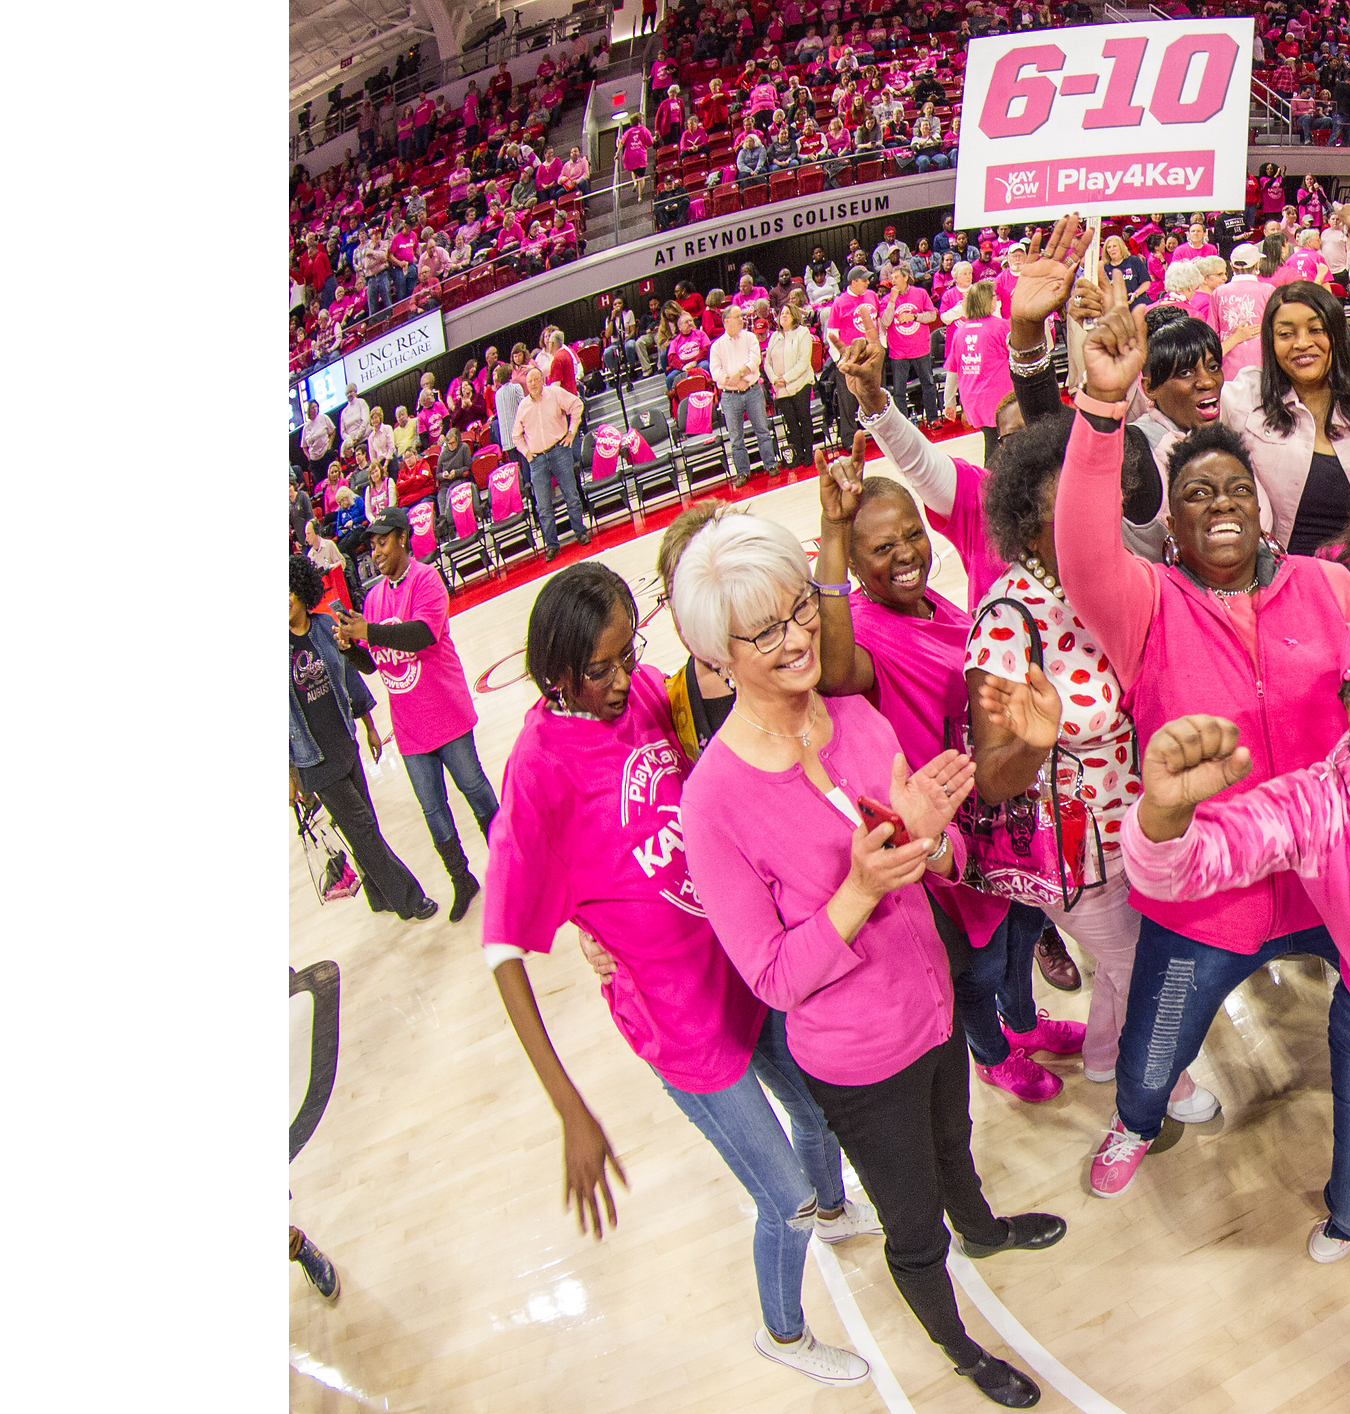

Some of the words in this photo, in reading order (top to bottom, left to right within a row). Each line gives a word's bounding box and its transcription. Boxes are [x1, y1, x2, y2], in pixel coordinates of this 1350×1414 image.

[978, 33, 1240, 139] 6-10
[1008, 170, 1037, 184] KAY
[1057, 163, 1205, 195] Play4Kay
[655, 246, 676, 267] AT
[684, 217, 784, 257] REYNOLDS
[793, 195, 890, 228] COLISEUM
[601, 294, 610, 307] H
[643, 281, 651, 292] J
[358, 343, 393, 371] UNC
[396, 324, 430, 352] REX
[360, 341, 432, 383] HEALTHCARE
[306, 683, 330, 703] AUGUS
[996, 876, 1059, 904] ay4Kay
